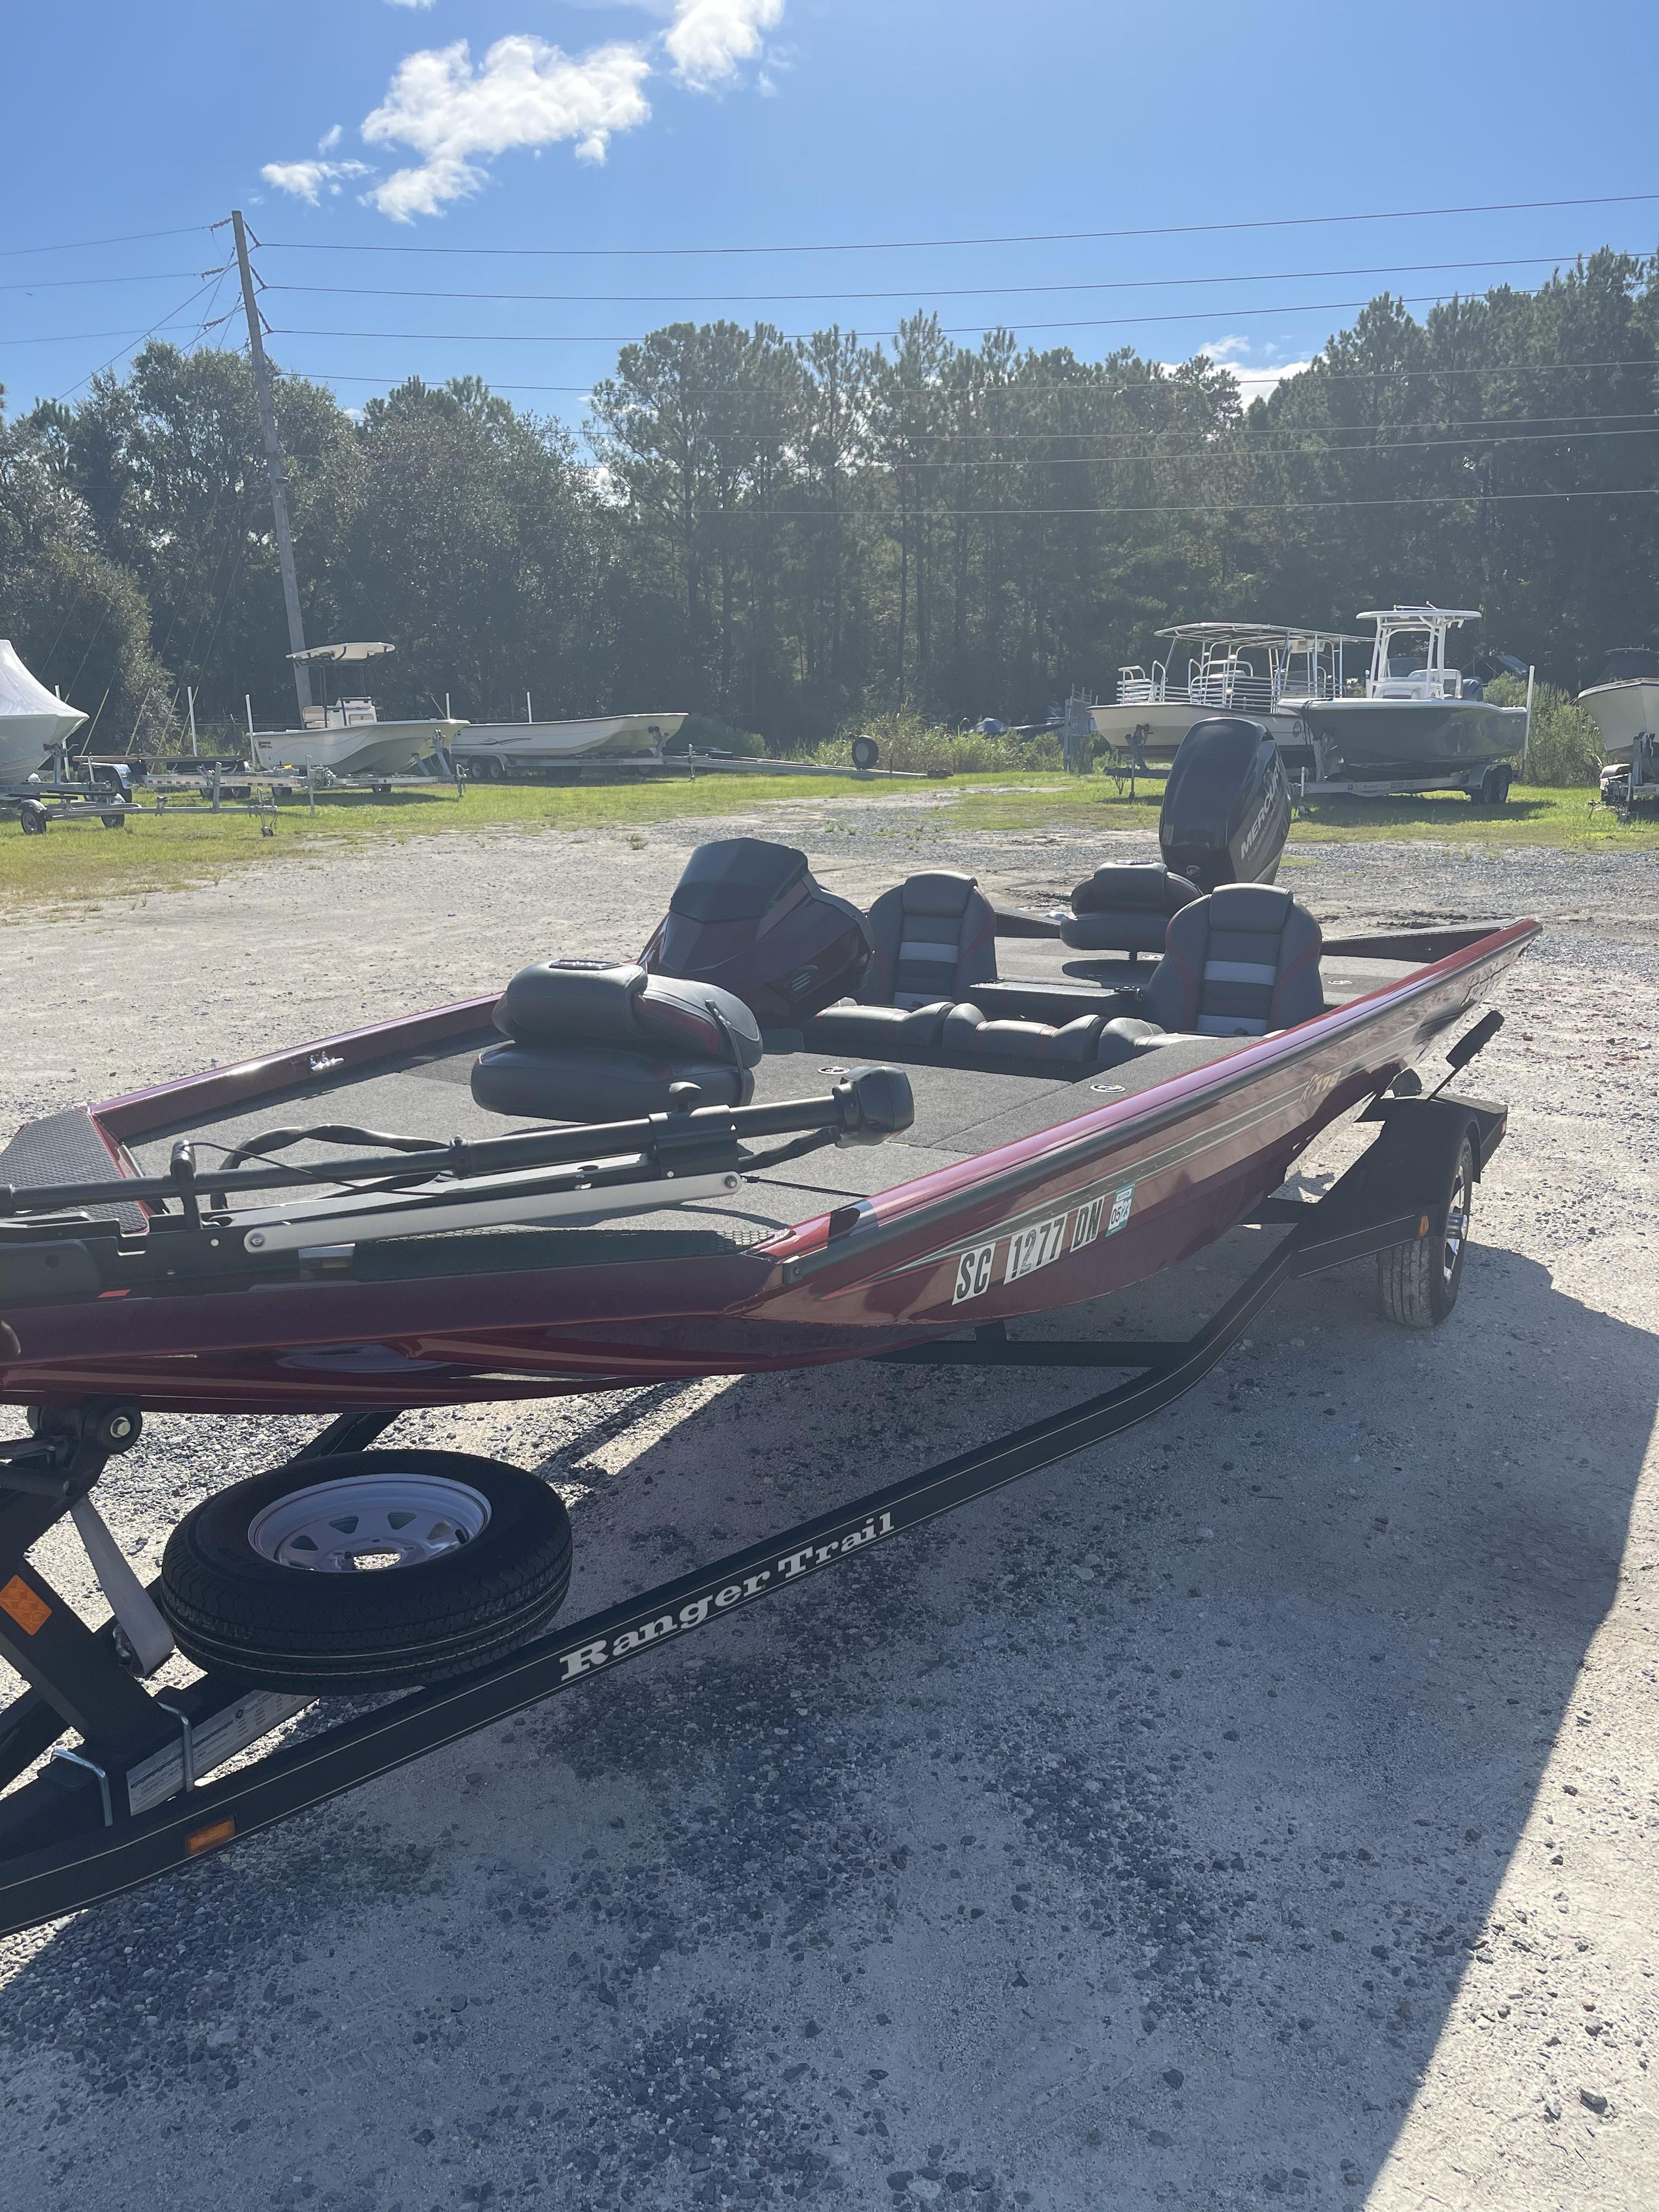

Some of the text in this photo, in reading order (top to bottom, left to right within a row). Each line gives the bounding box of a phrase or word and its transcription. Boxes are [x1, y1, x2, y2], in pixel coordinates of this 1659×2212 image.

[956, 1198, 1104, 1300] SC 1277 DN
[559, 1511, 894, 1680] Ranger Trail
